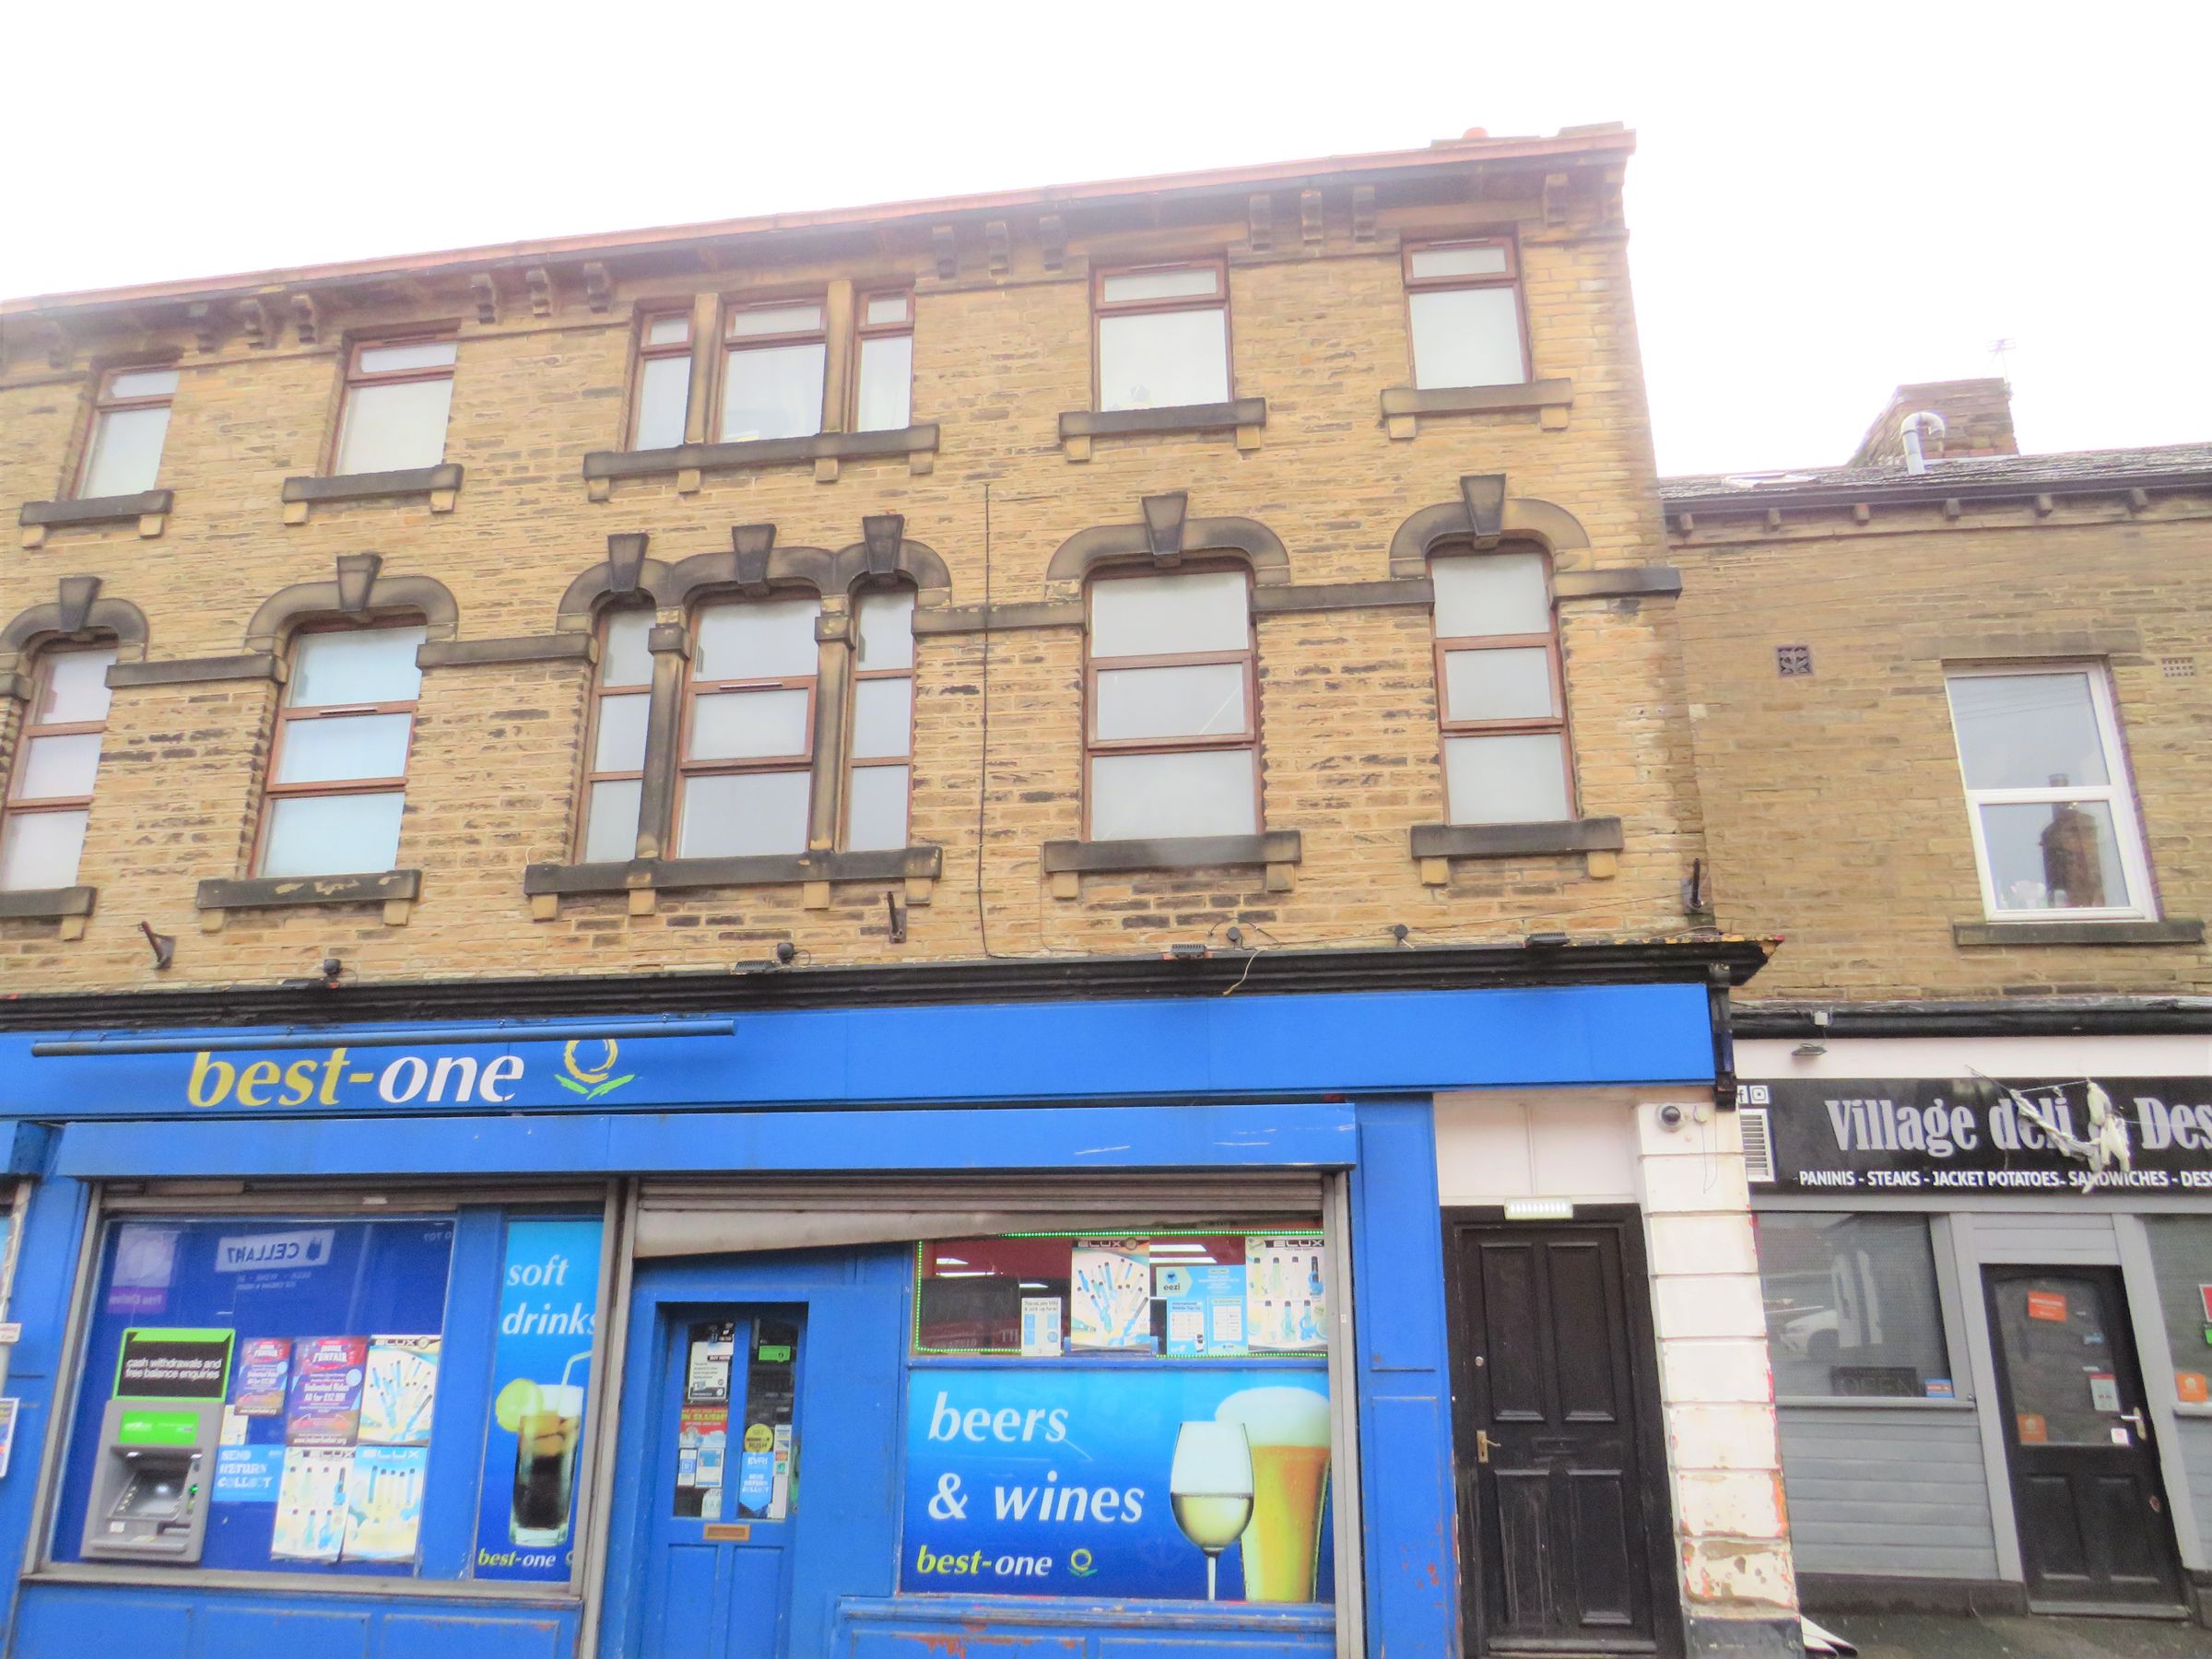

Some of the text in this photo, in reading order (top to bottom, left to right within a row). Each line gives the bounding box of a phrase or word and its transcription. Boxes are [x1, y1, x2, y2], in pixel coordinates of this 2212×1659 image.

[187, 1048, 524, 1107] best-one
[1825, 1099, 1978, 1158] Village
[1799, 1171, 1856, 1186] PANINIS
[1866, 1171, 1921, 1186] STEAKS
[1933, 1171, 1985, 1186] JACKET
[507, 1254, 570, 1286] soft
[1163, 1282, 1181, 1291] eezi
[126, 1357, 222, 1370] cash withdrawals and
[124, 1368, 220, 1382] free balance enquiries
[928, 1391, 1069, 1442] beers
[220, 1450, 253, 1461] SEND
[747, 1456, 769, 1465] EVRI
[927, 1469, 1145, 1523] & wines
[478, 1548, 557, 1567] best-one
[916, 1544, 1053, 1576] best-one
